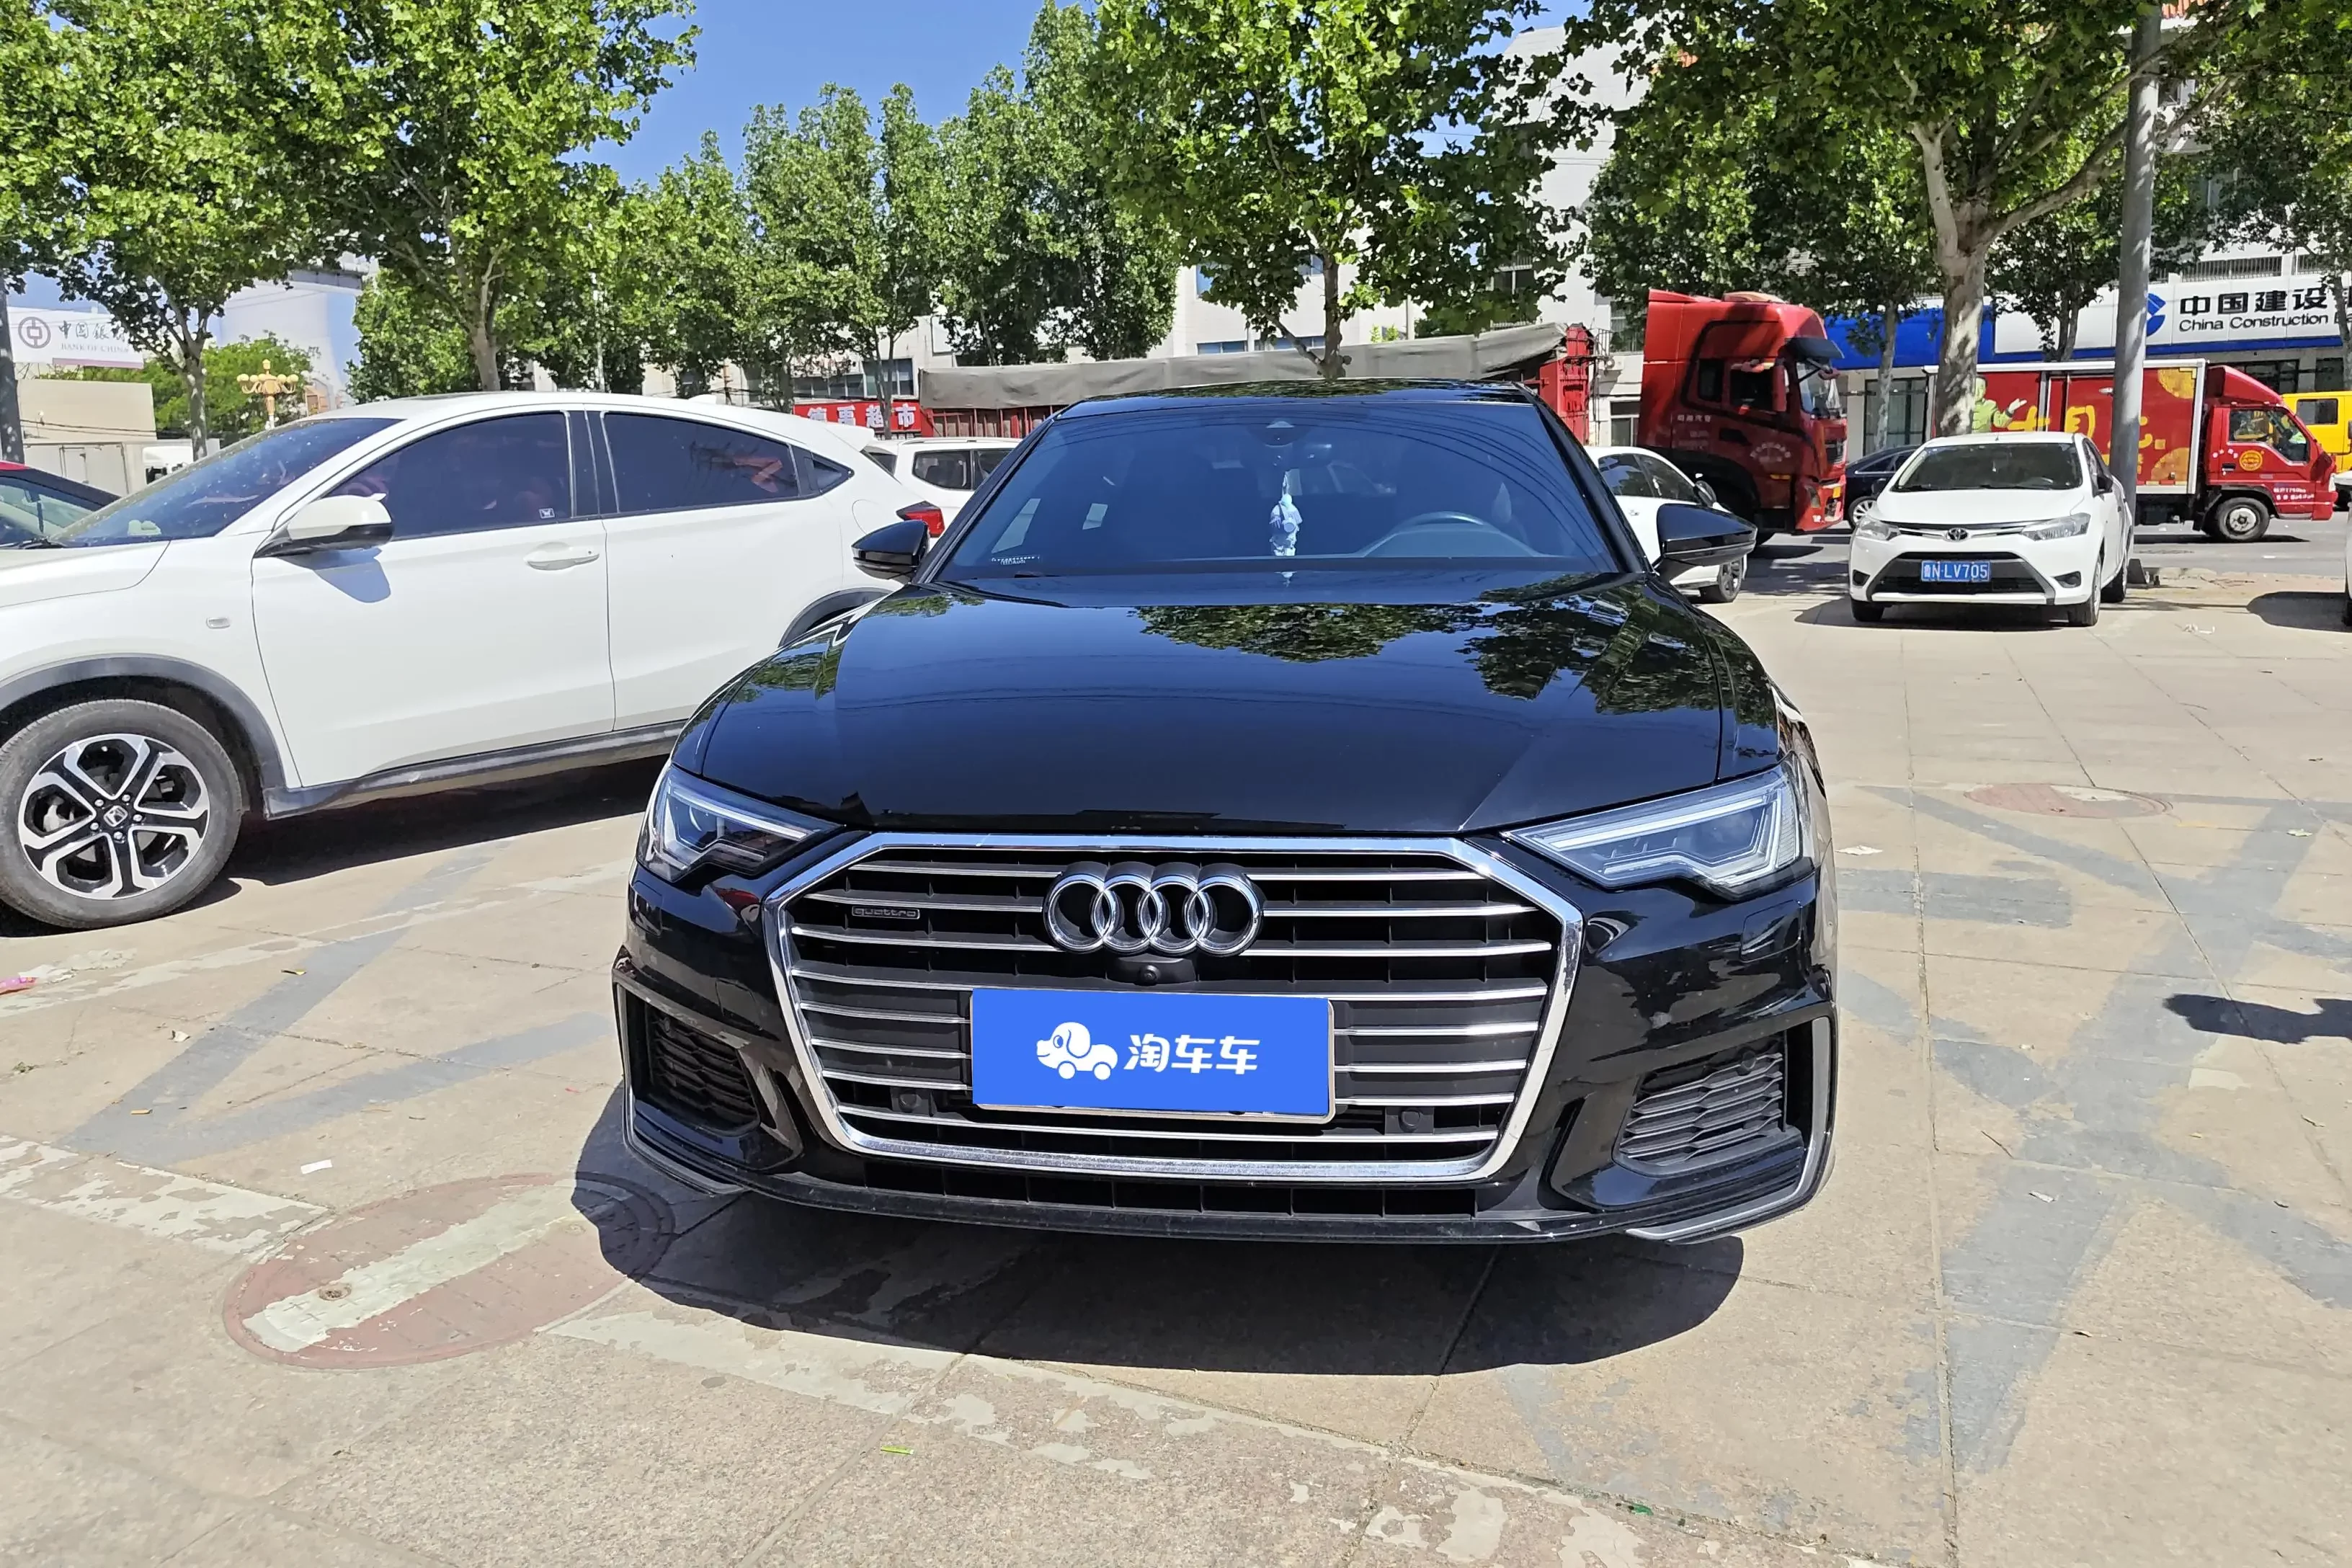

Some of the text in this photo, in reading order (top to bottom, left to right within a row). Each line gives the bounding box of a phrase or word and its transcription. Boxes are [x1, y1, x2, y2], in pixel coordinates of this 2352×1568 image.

[2180, 318, 2224, 331] China
[2230, 313, 2328, 329] Construction
[855, 908, 916, 917] quattro
